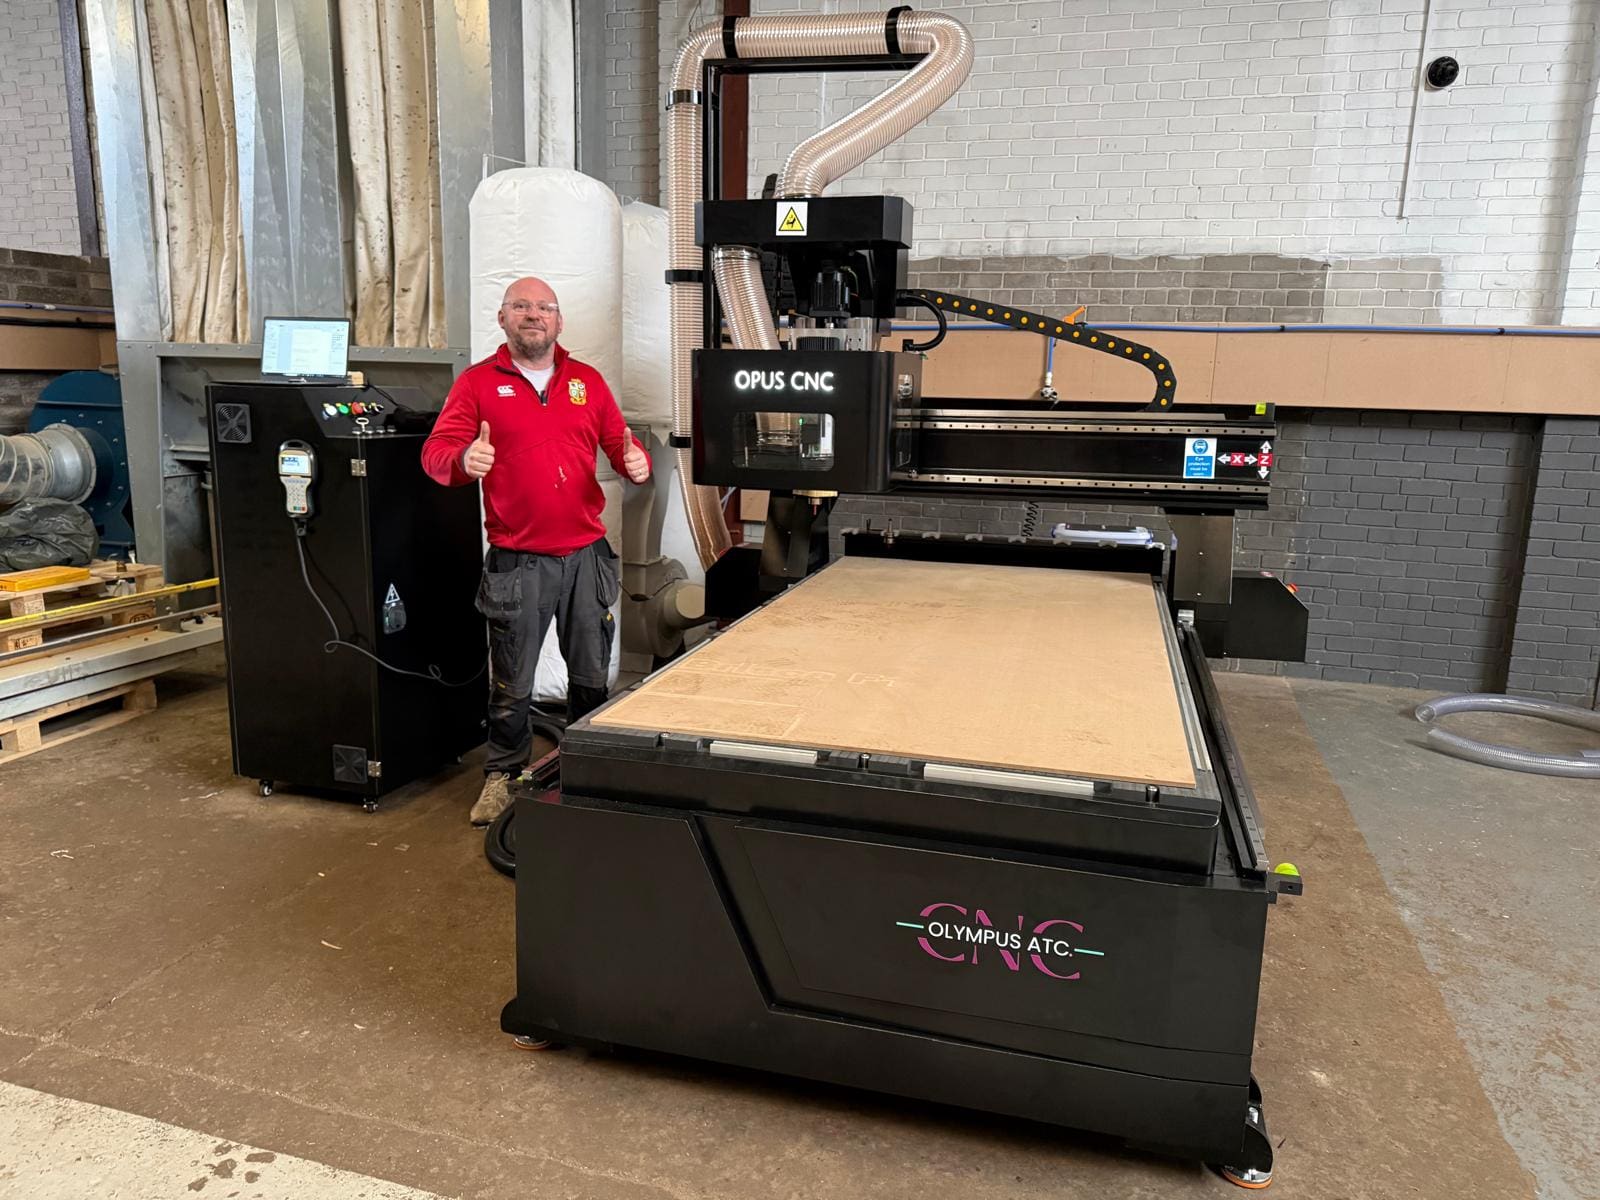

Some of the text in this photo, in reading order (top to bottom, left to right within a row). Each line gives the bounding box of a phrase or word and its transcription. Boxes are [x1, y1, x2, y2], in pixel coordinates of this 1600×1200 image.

[734, 369, 834, 391] OPUS CNC
[1233, 455, 1242, 464] X
[1260, 455, 1270, 465] Z
[927, 921, 1022, 949] OLYMPUS
